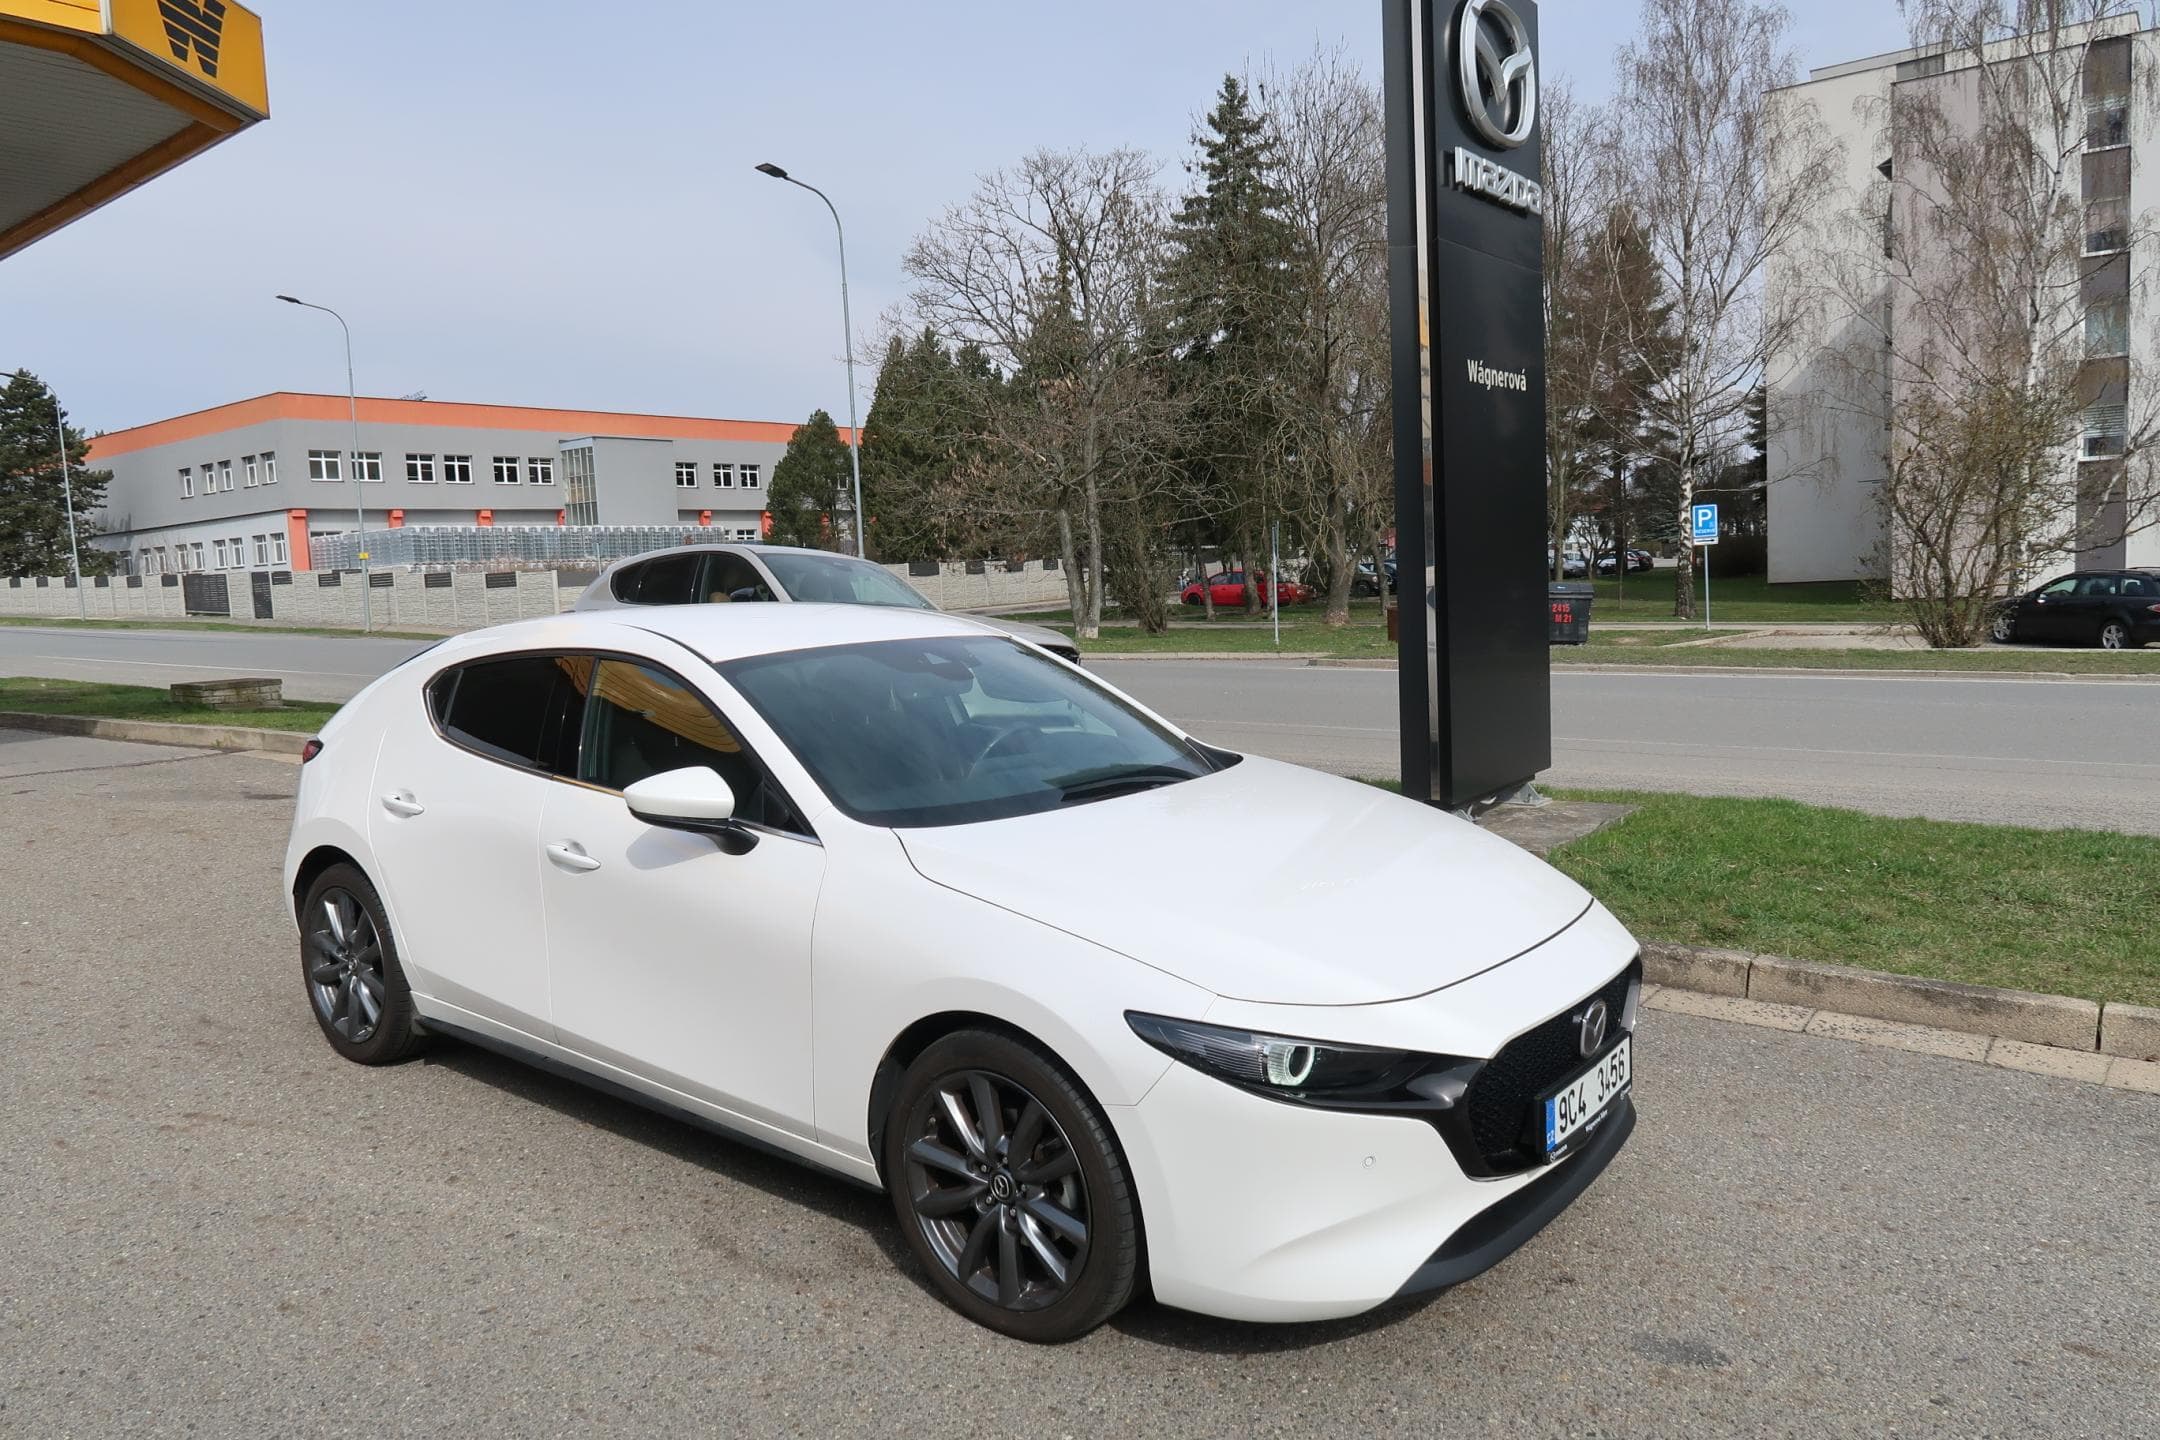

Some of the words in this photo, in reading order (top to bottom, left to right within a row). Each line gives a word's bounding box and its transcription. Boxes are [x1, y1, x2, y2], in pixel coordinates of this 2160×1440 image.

[1466, 359, 1527, 392] Wágnerová
[1698, 508, 1712, 527] P
[1559, 1081, 1587, 1133] 9C4
[1597, 1048, 1625, 1103] 3456
